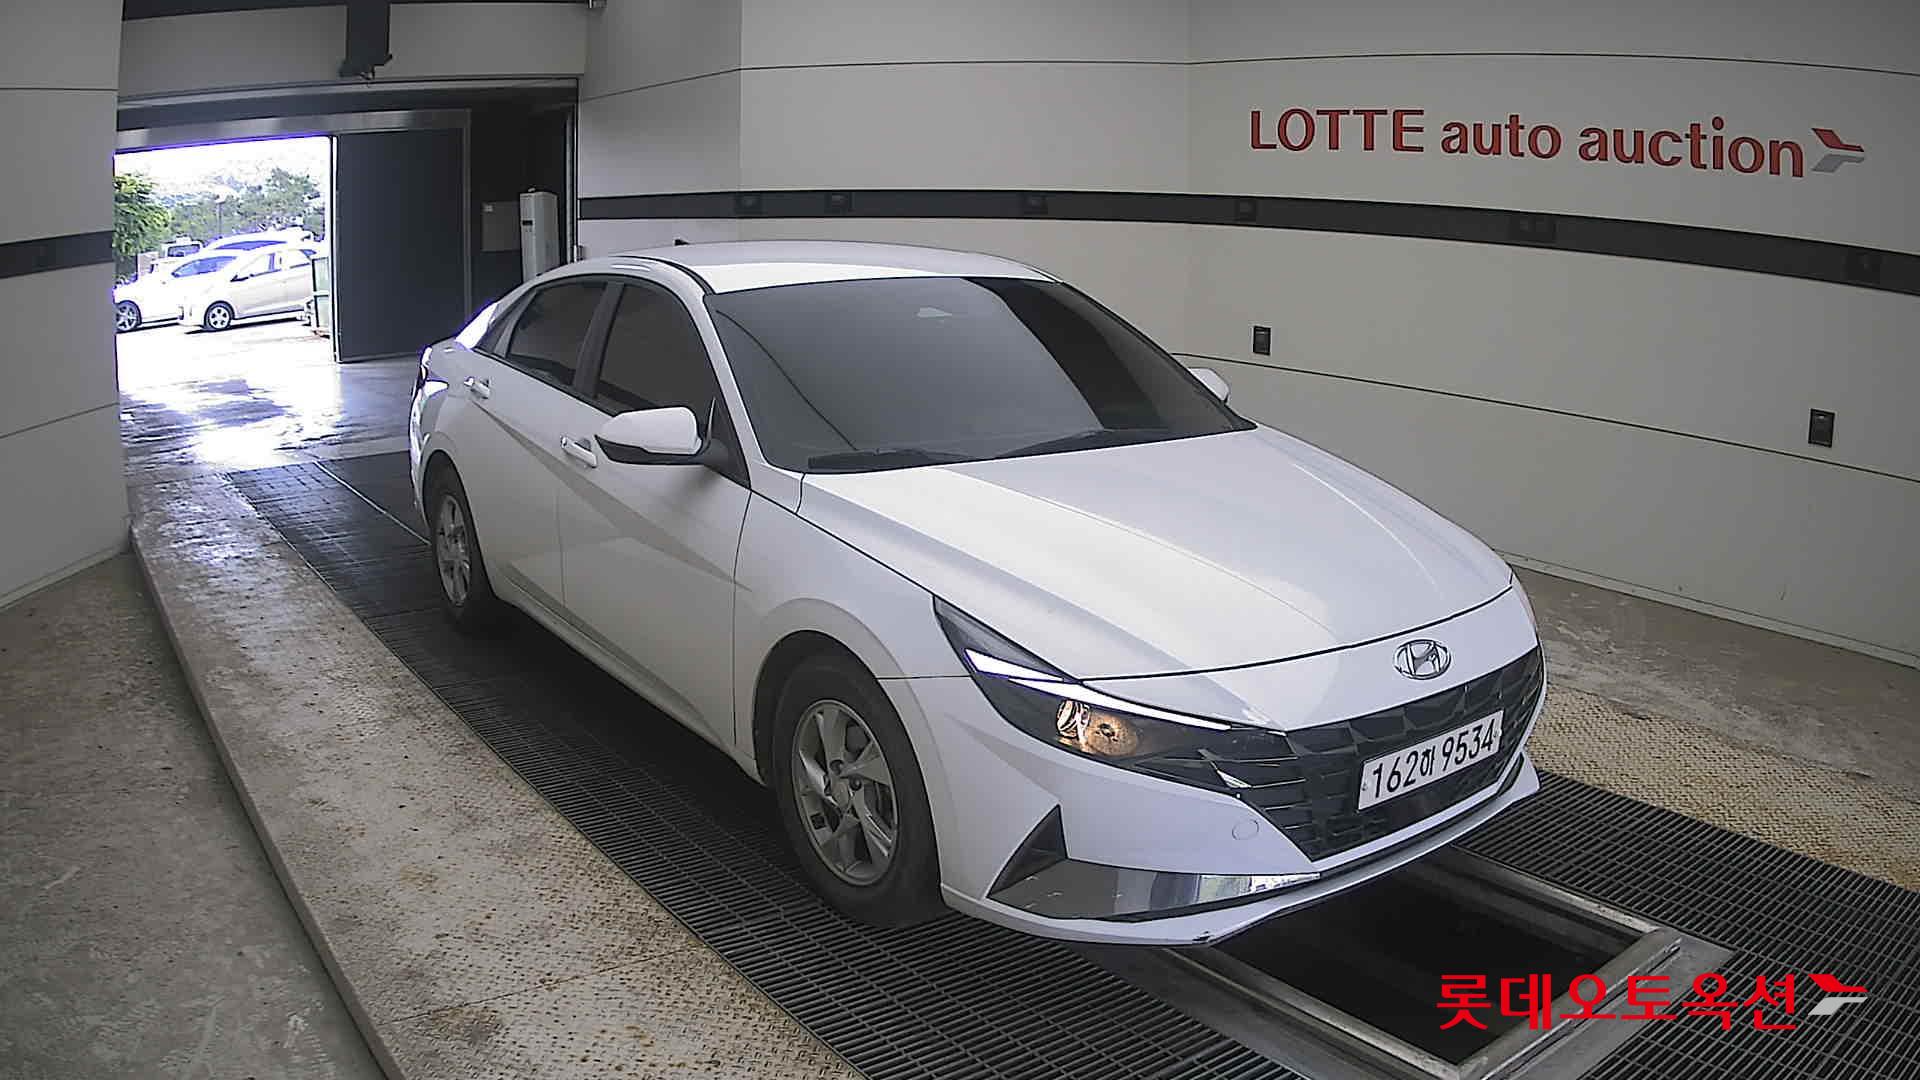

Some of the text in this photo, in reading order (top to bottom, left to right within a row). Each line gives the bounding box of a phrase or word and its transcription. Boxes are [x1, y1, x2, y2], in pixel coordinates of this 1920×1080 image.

[1250, 109, 1805, 178] LOTTE auto auction
[1441, 718, 1496, 772] 9534
